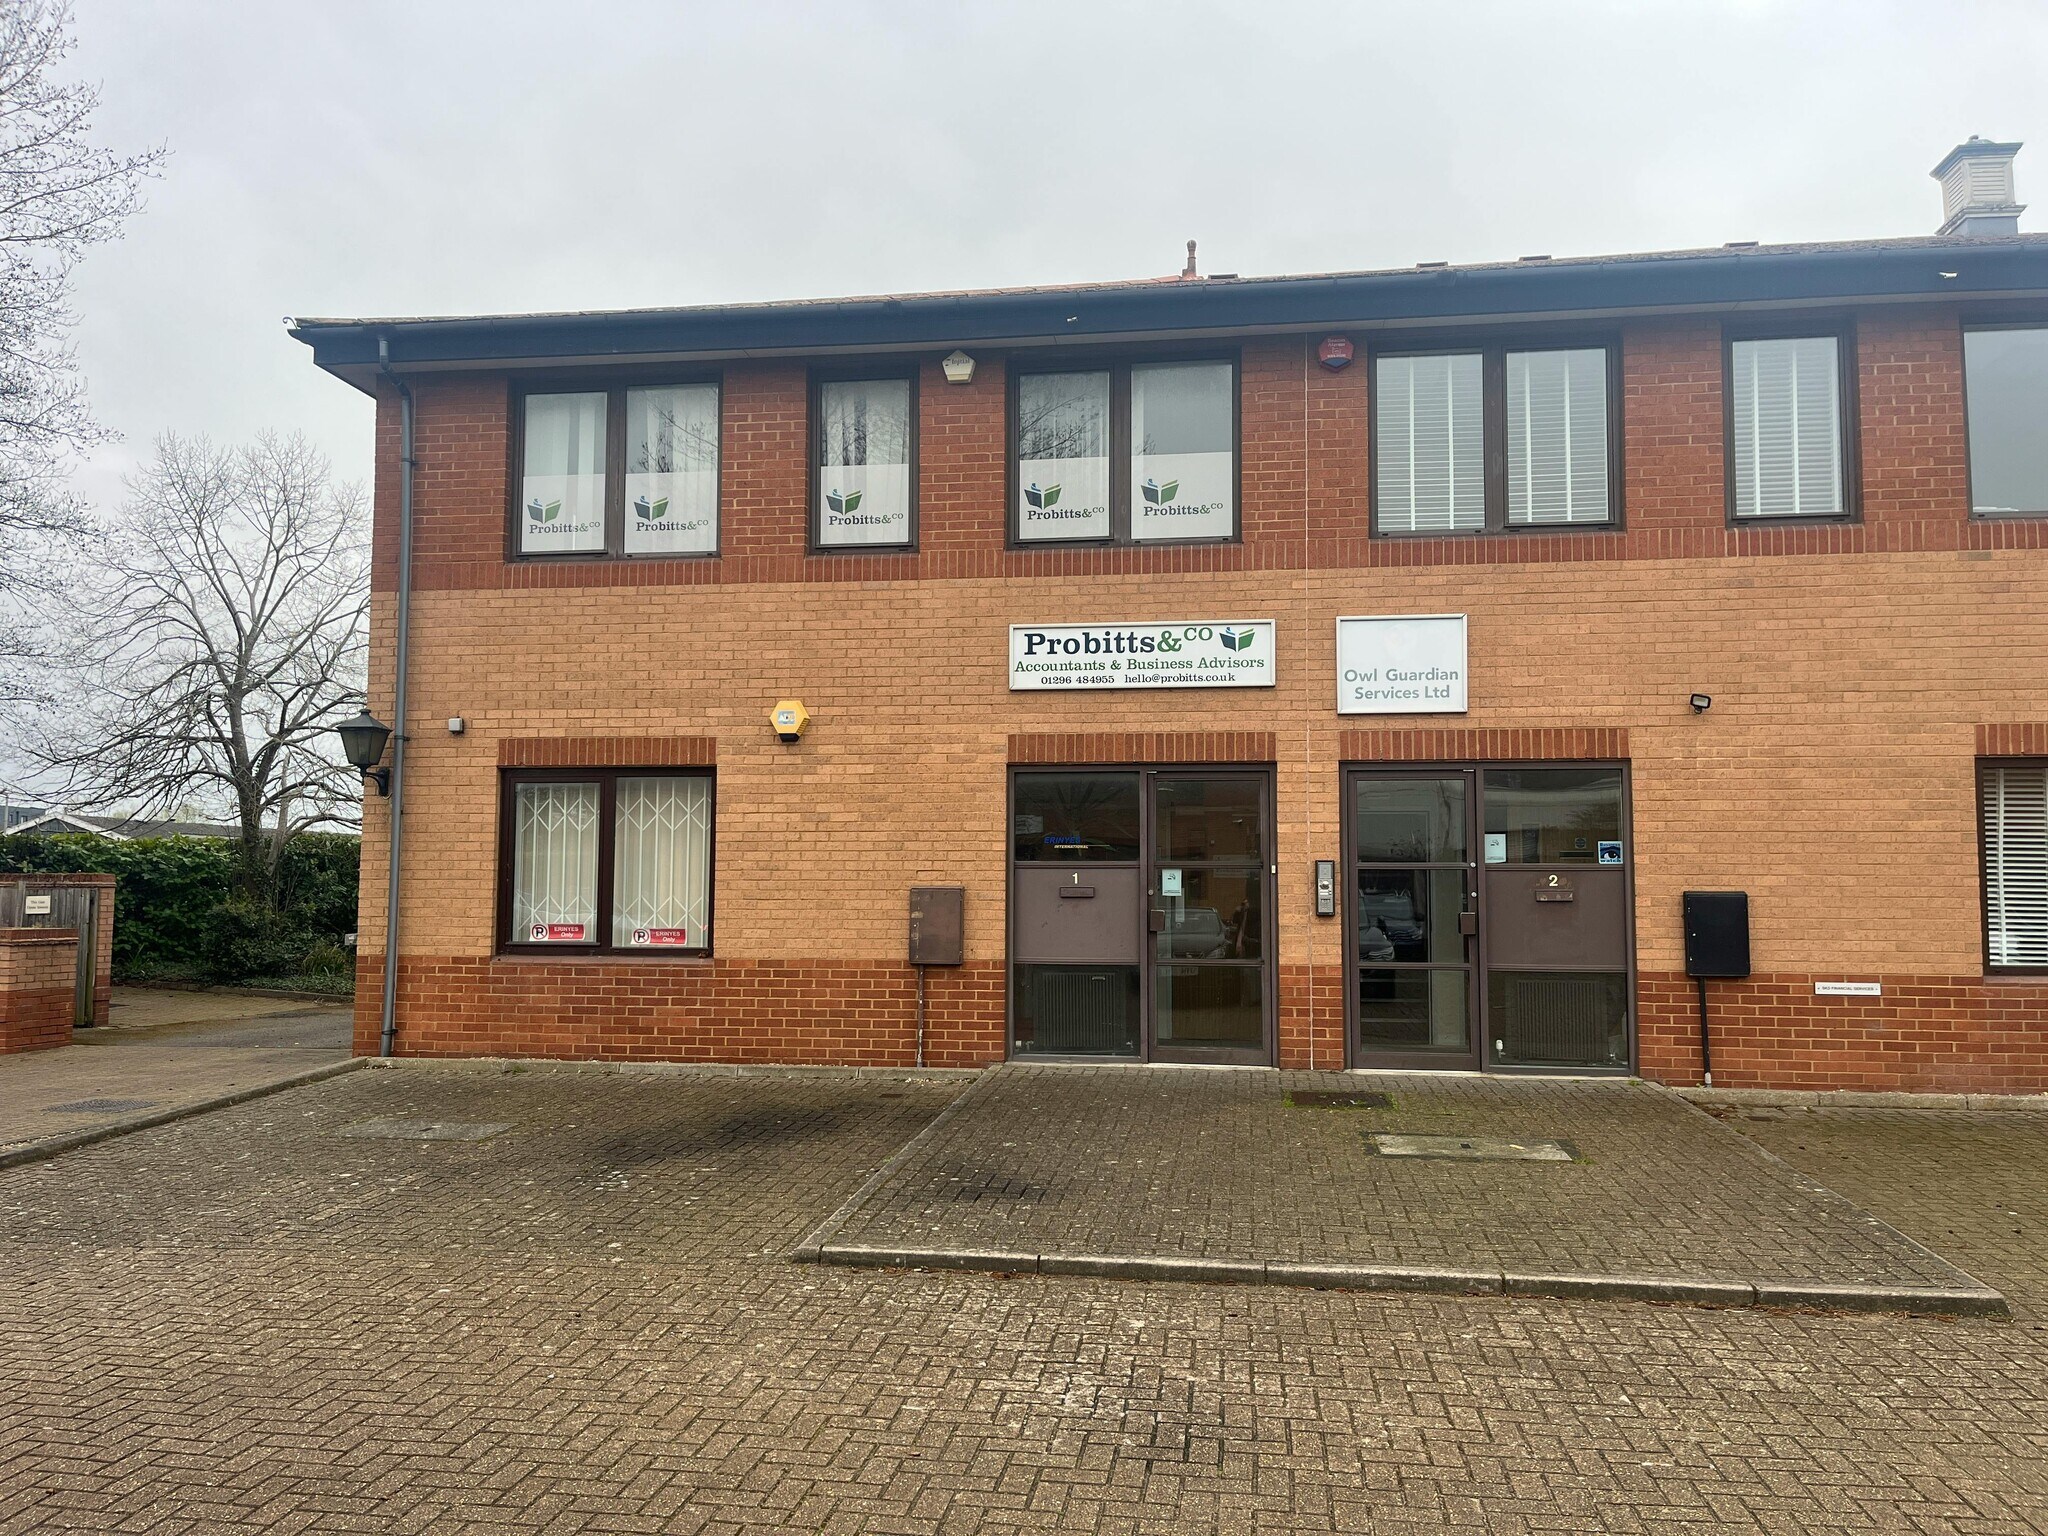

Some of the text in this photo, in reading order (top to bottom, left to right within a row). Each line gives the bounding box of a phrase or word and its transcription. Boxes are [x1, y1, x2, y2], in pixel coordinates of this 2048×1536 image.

[1014, 656, 1265, 672] Accountants & Business Advisors
[1041, 672, 1236, 685] 01296 484955 hello@probitts.co.uk
[1344, 667, 1459, 682] Owl Guardian
[1354, 685, 1450, 699] Services Ltd
[1072, 872, 1078, 884] 1
[1548, 874, 1559, 887] 2
